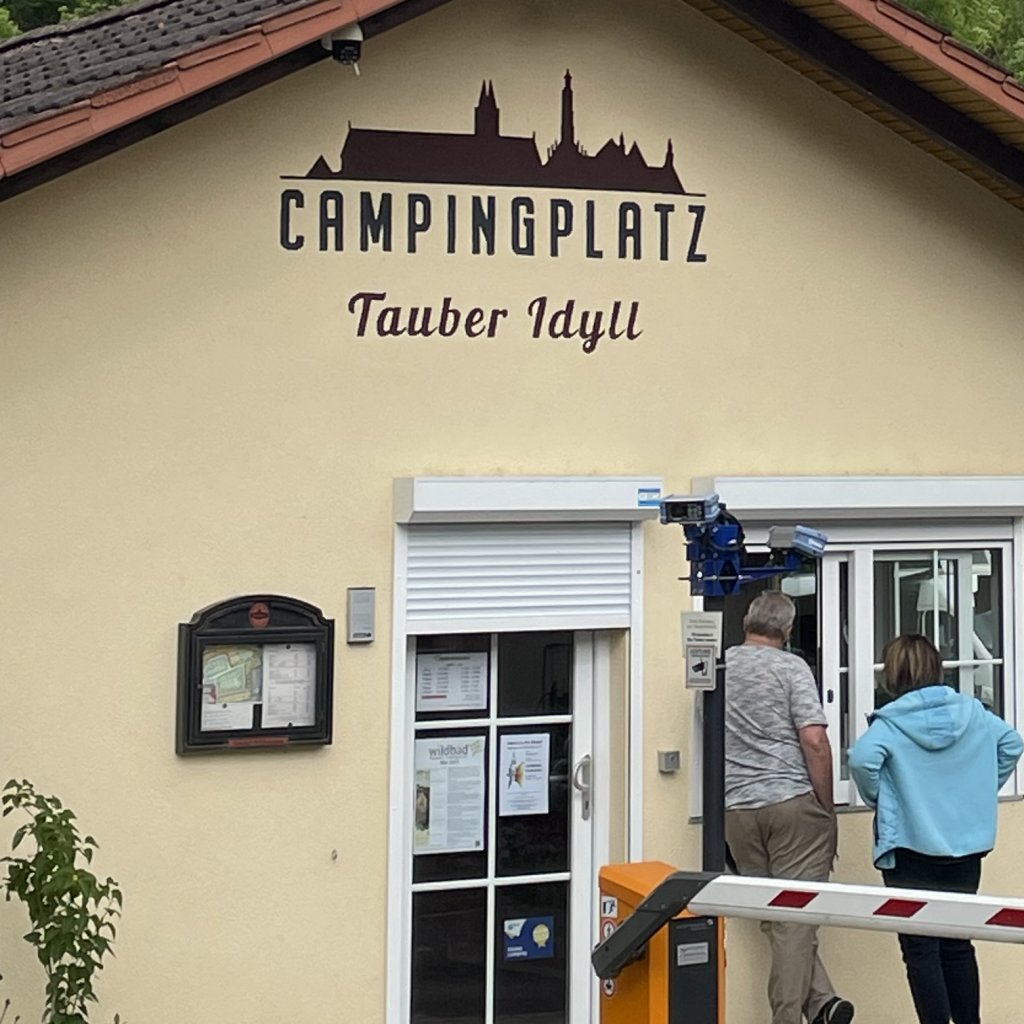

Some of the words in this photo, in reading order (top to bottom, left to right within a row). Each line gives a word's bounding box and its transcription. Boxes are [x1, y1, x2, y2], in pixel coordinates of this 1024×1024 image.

[279, 188, 707, 262] CAMPINGPLATZ
[348, 292, 508, 338] Tauber
[527, 295, 643, 354] Idyll
